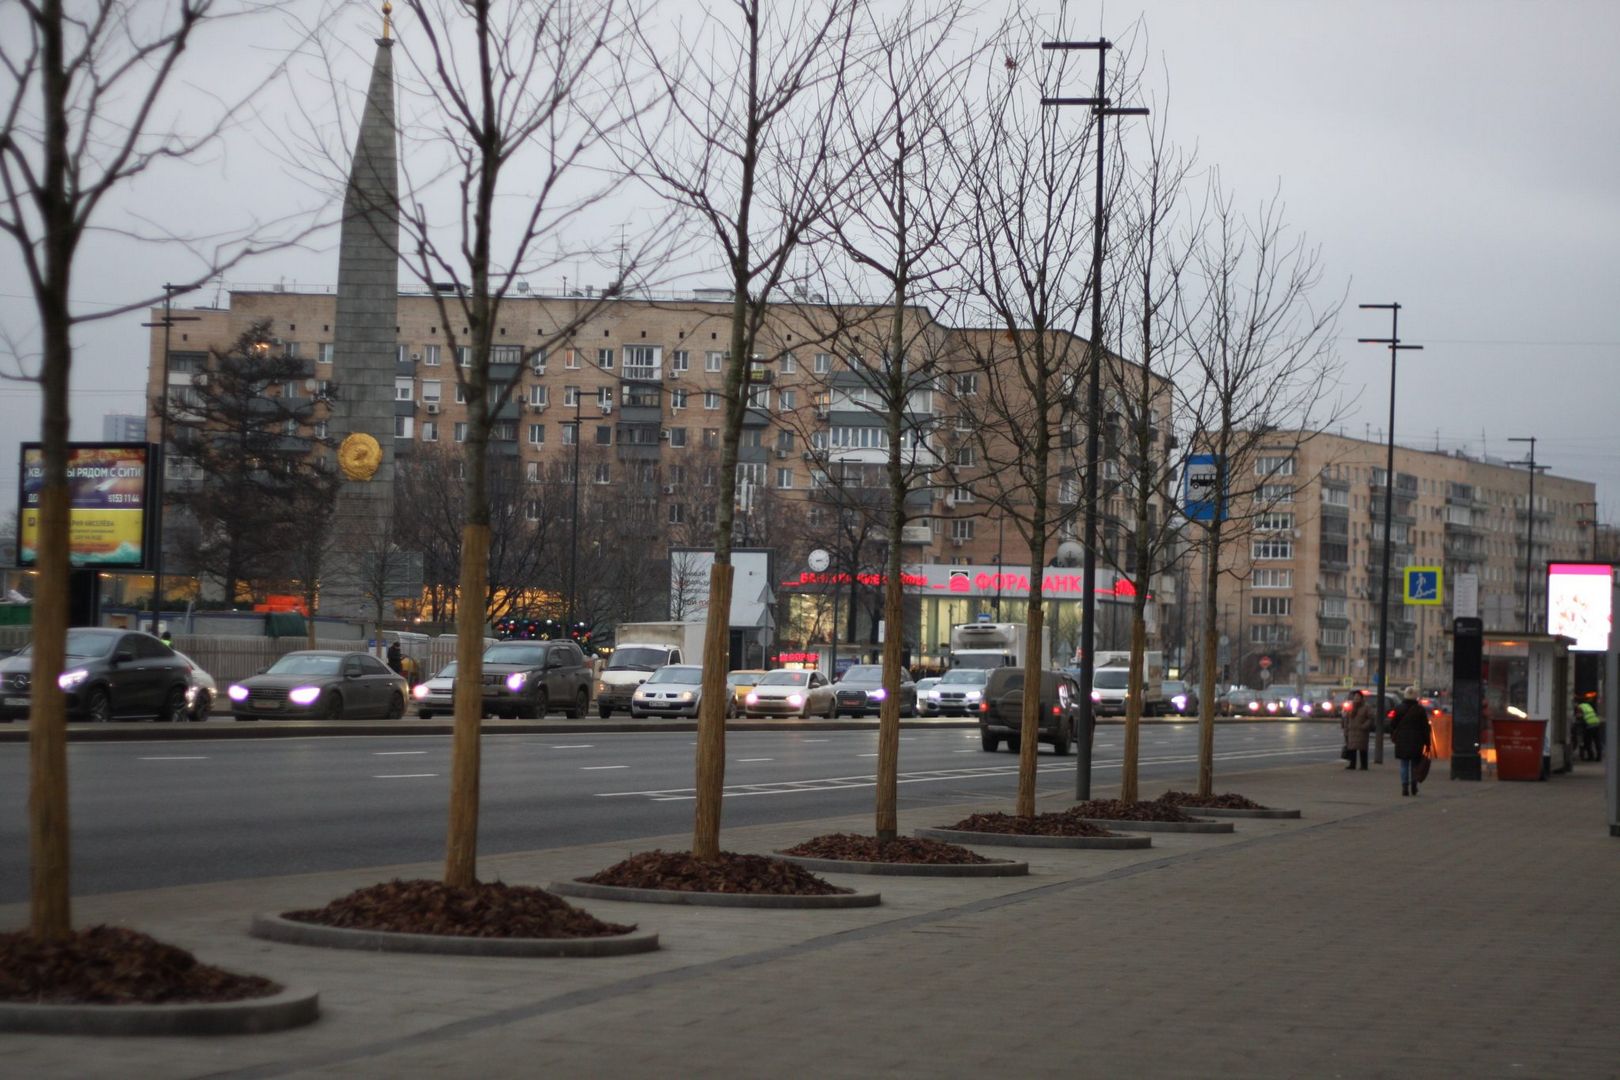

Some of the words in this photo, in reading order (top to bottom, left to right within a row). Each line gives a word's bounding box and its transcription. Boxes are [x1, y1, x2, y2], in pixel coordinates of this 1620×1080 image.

[77, 467, 107, 479] РЯДОМ
[110, 467, 116, 478] С
[975, 573, 1082, 593] ФОРААНК
